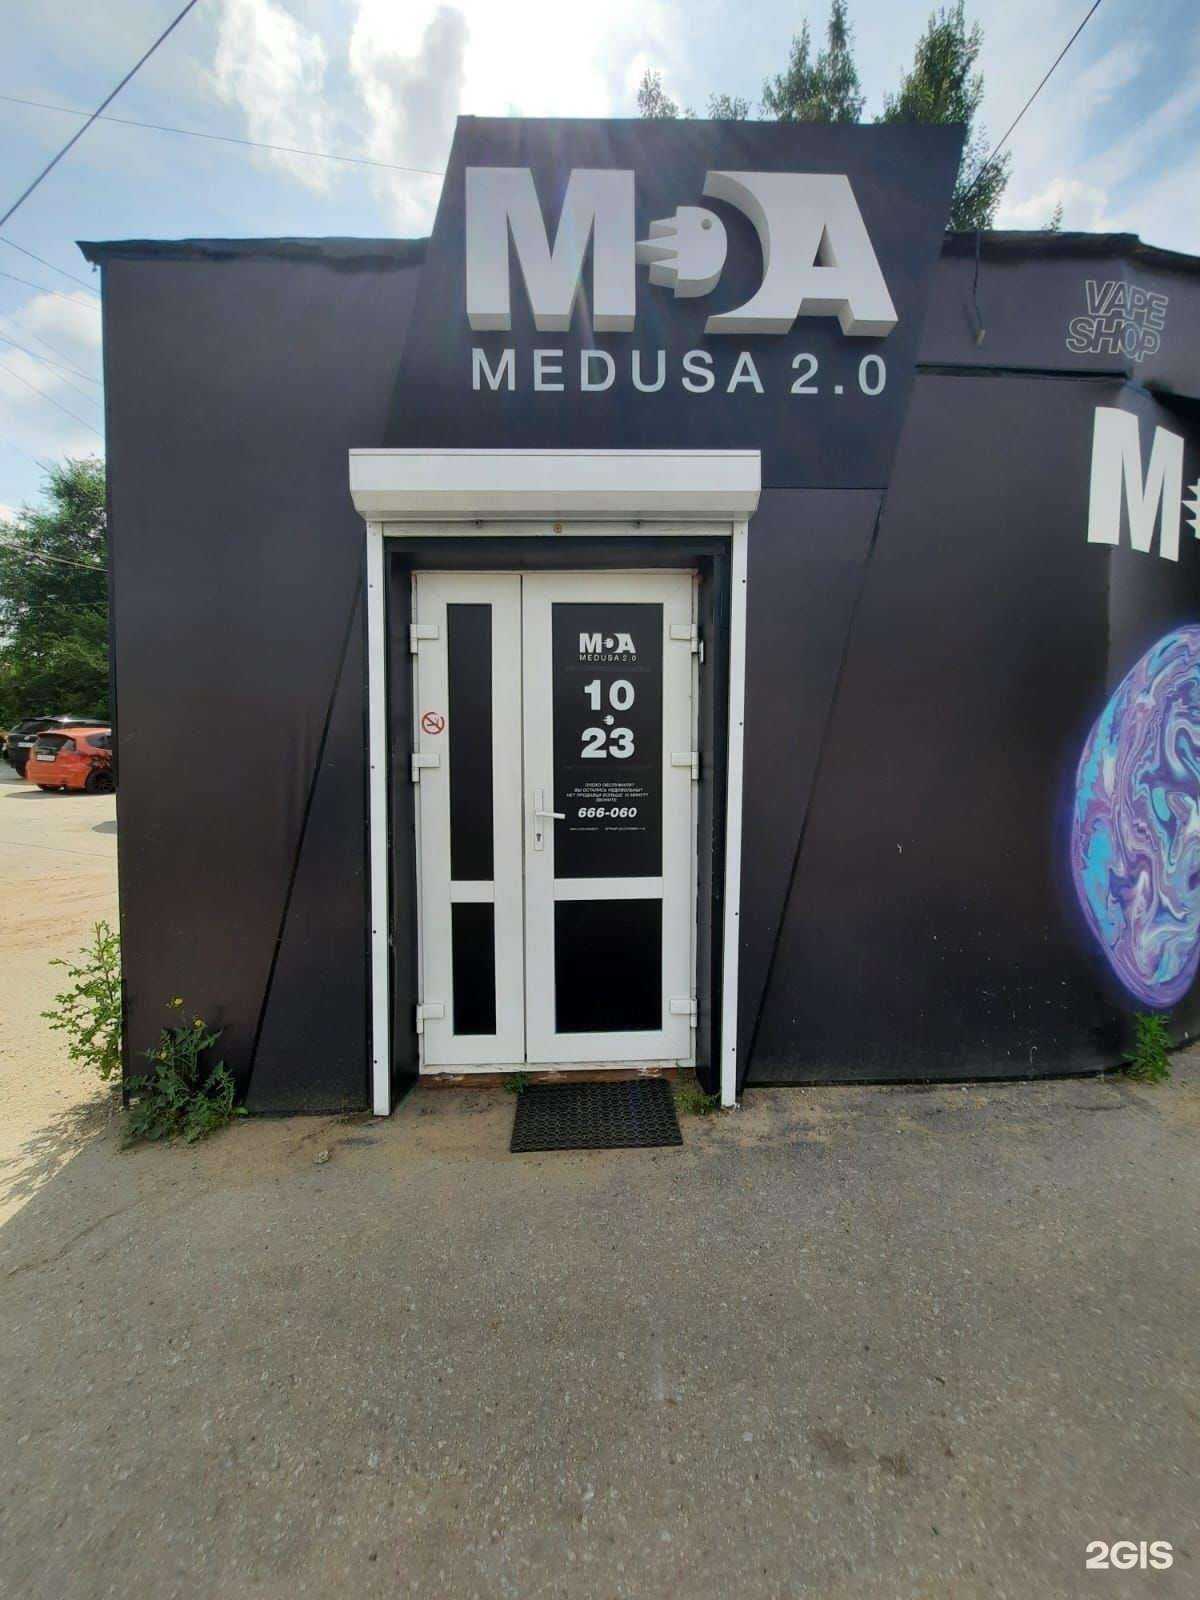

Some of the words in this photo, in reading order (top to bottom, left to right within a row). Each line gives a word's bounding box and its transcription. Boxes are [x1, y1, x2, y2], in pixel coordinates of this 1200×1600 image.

[1085, 280, 1169, 330] VAPE
[1065, 316, 1161, 362] SHOP
[471, 347, 765, 394] MEDUSA
[790, 352, 888, 395] 2.0
[579, 654, 620, 662] MEDUSA
[622, 654, 637, 662] 2.0
[584, 679, 635, 711] 10
[581, 727, 635, 759] 23
[578, 807, 637, 818] 666-060
